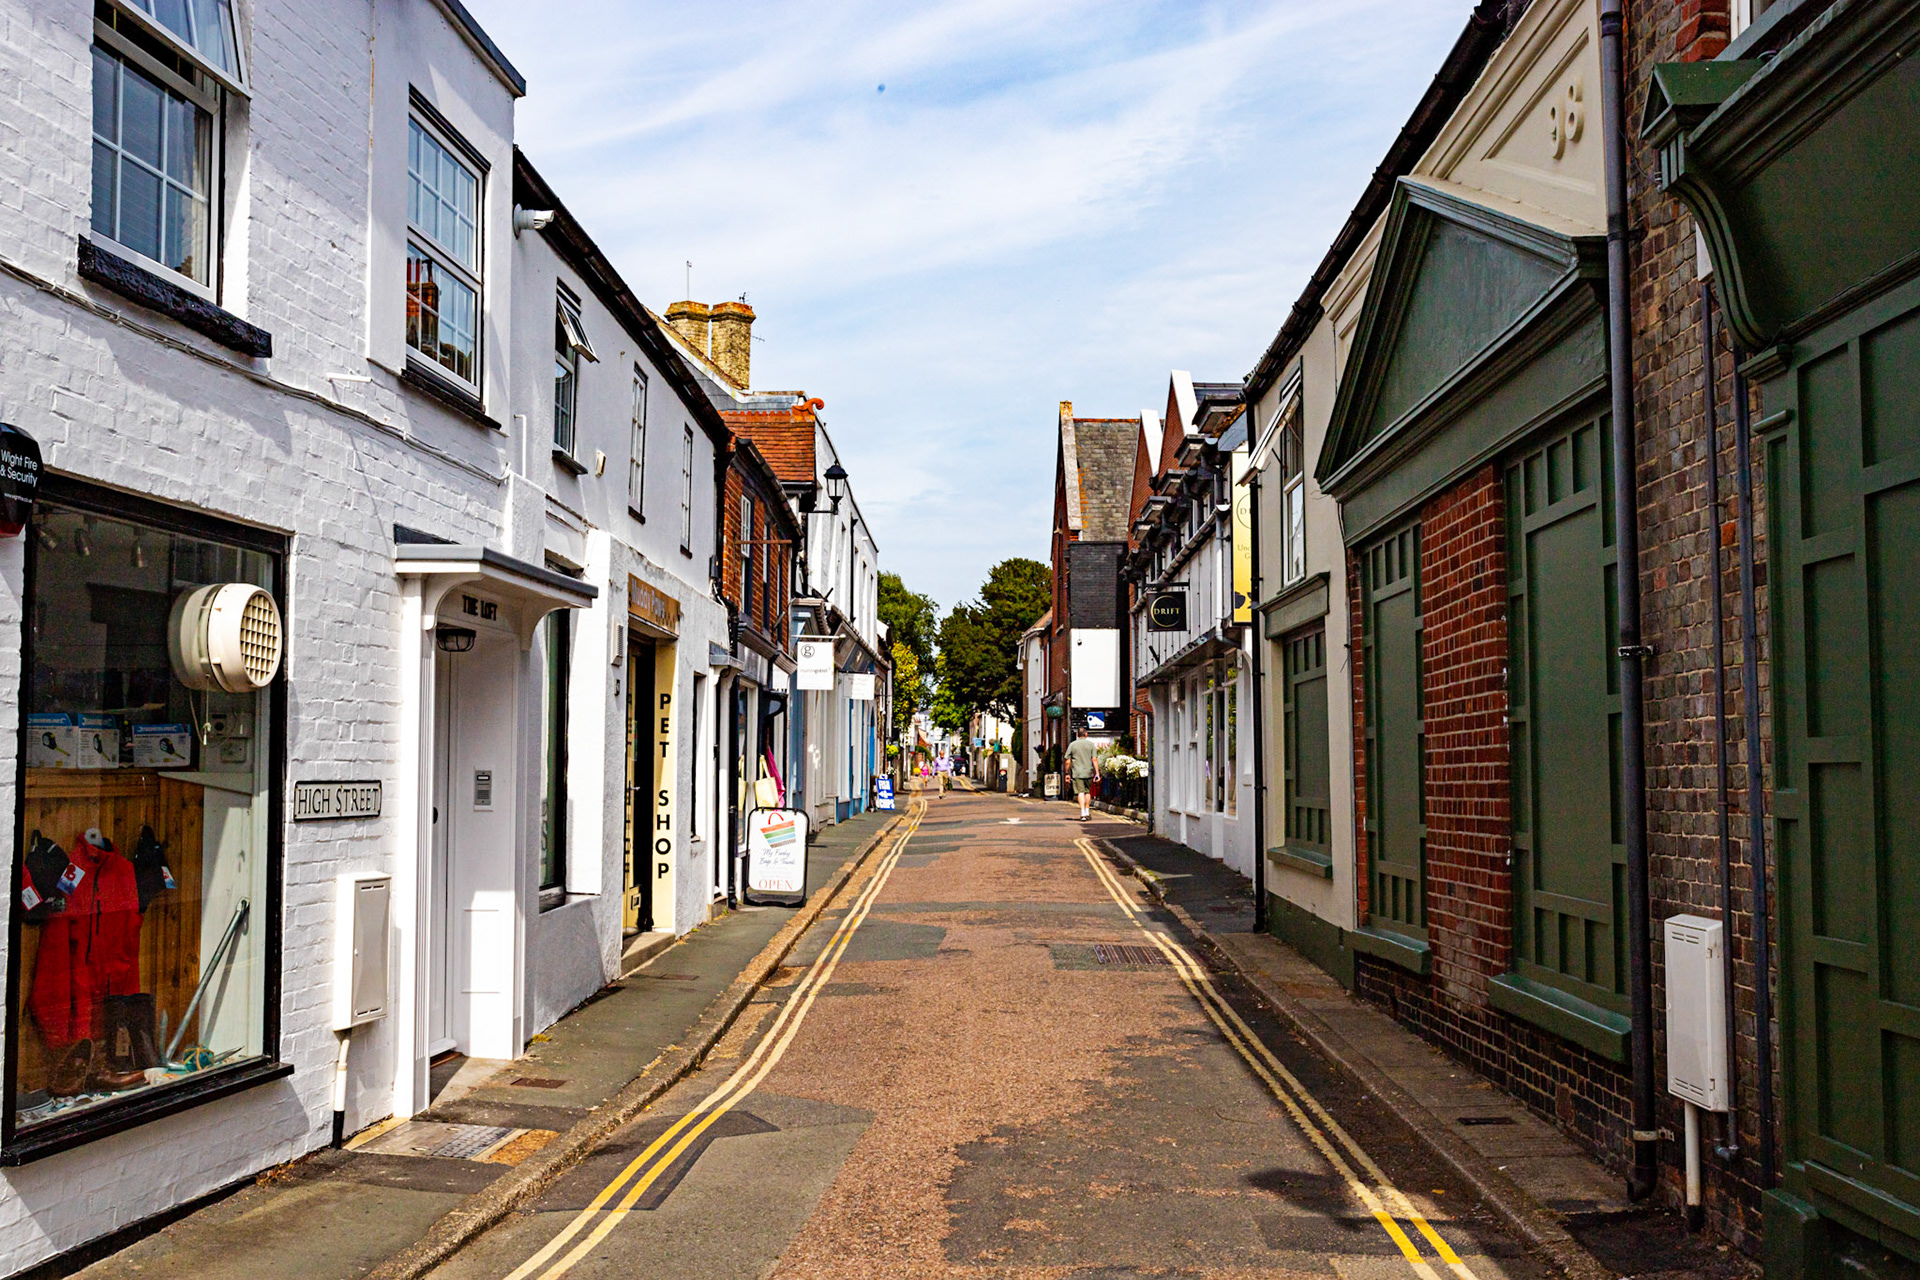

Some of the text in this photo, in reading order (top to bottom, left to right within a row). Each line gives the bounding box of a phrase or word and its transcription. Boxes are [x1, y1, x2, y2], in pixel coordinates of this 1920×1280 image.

[1, 449, 38, 471] Wight Fire
[0, 464, 38, 488] & Security
[1153, 607, 1180, 615] DRIFT
[655, 693, 672, 879] PET SHOP
[297, 787, 379, 814] HIGH STREET
[758, 879, 793, 890] OPEN
